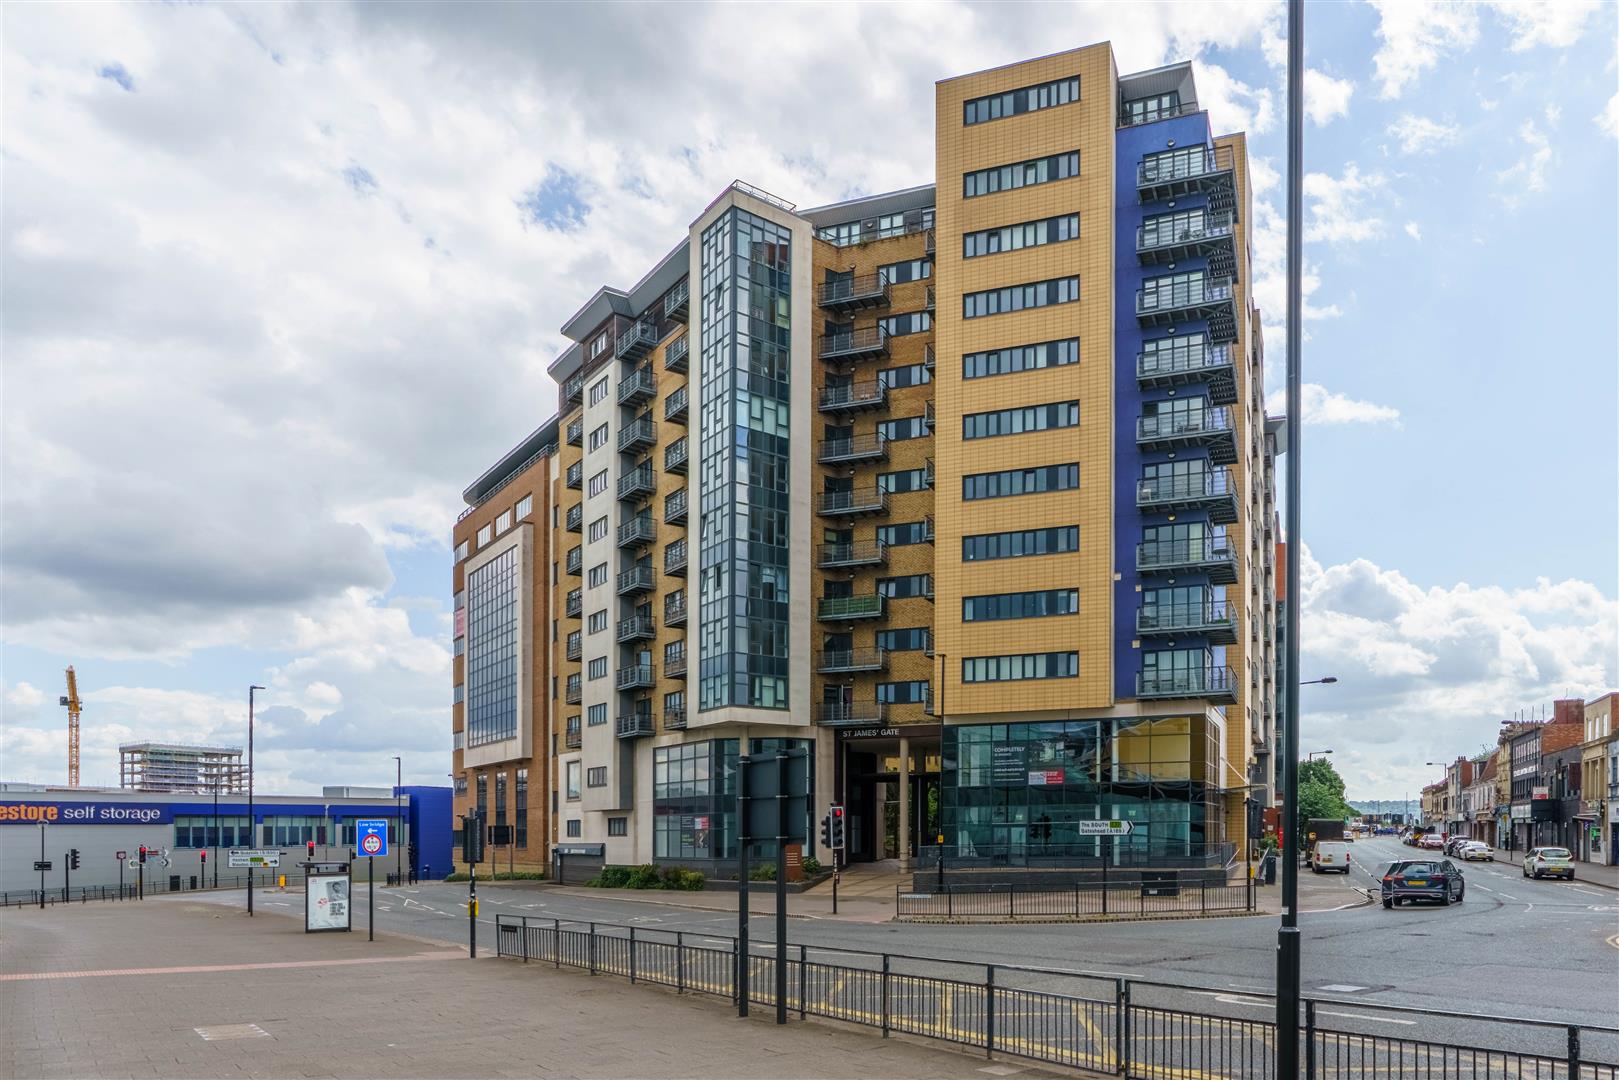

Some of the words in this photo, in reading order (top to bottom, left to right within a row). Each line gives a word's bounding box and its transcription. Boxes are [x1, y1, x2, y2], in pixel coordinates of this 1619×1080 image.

[843, 730, 852, 738] ST
[881, 728, 900, 736] GATE
[0, 804, 58, 820] estore
[64, 805, 96, 819] self
[100, 806, 161, 822] storage
